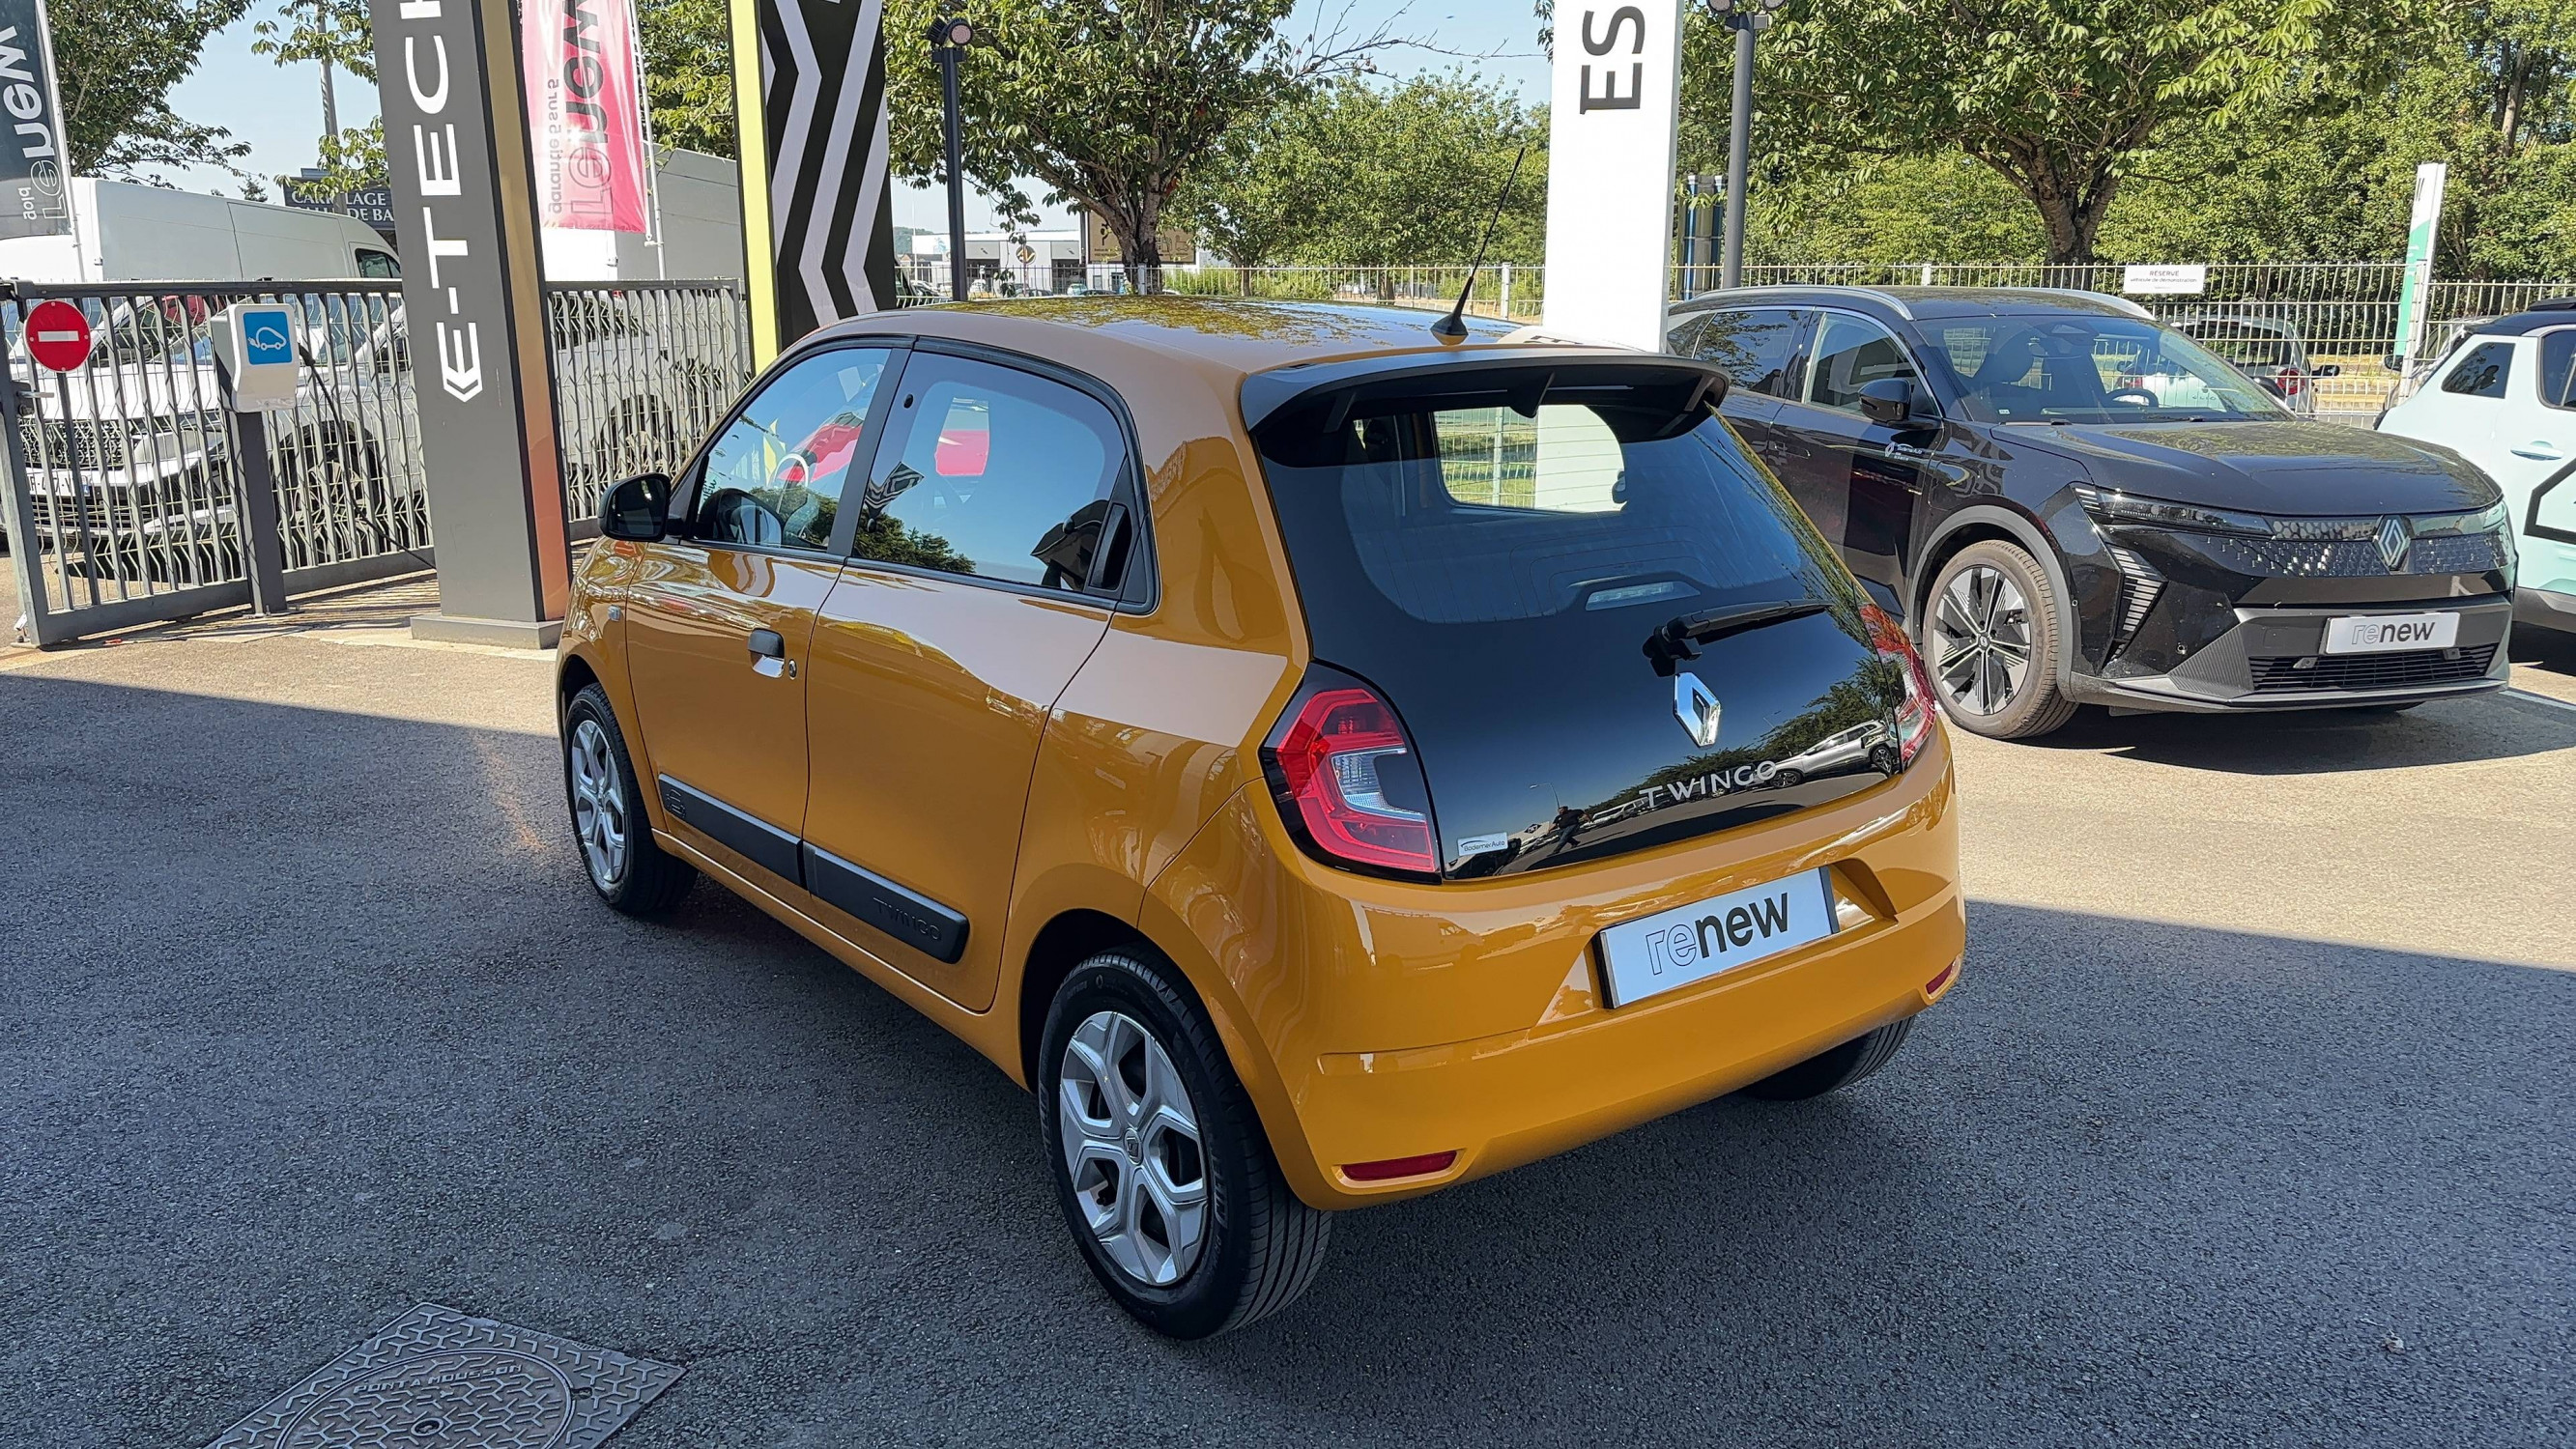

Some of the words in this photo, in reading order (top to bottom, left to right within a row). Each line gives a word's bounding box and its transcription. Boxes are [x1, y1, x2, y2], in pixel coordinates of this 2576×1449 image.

[1580, 6, 1646, 115] ES
[291, 190, 386, 206] CARRLAGE
[399, 0, 483, 403] E-TEC
[2351, 621, 2436, 645] renew
[1638, 760, 1777, 809] TWINGO
[873, 896, 943, 942] TWINGO
[1645, 892, 1789, 976] renew
[427, 1364, 524, 1385] MOUSSON
